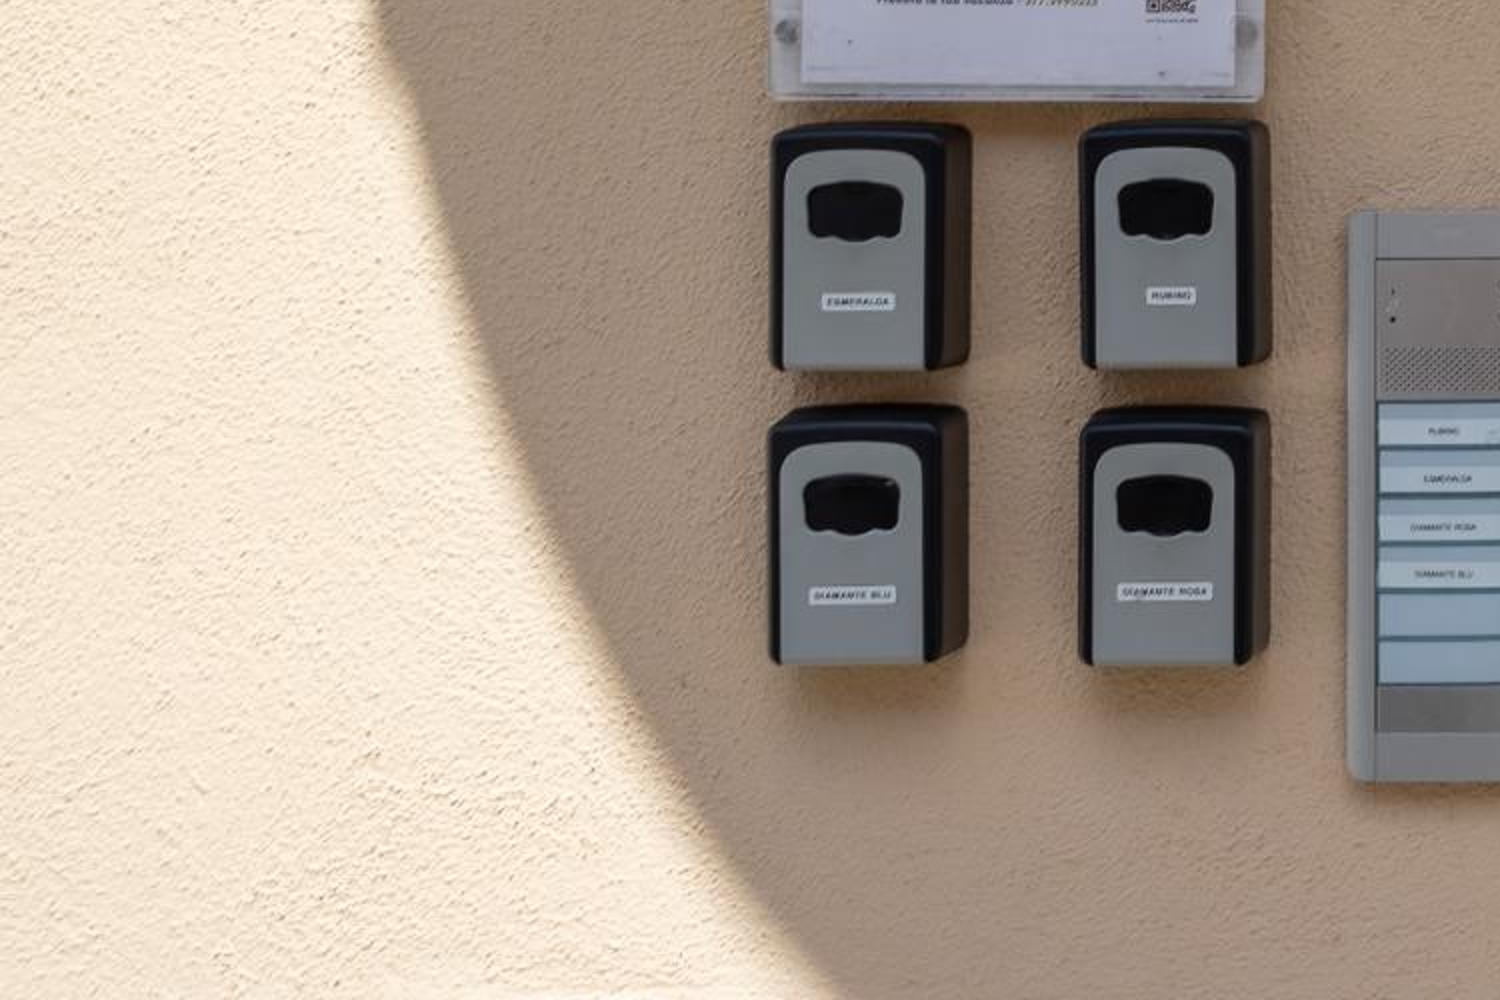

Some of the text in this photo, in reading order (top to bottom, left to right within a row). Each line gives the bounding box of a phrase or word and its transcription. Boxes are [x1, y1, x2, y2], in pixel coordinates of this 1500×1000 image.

[1151, 290, 1191, 300] RUBINO
[826, 297, 889, 306] ESMERALDA
[814, 590, 892, 600] DIAMANTE BLU
[1122, 586, 1207, 597] DIAMANTE ROSA
